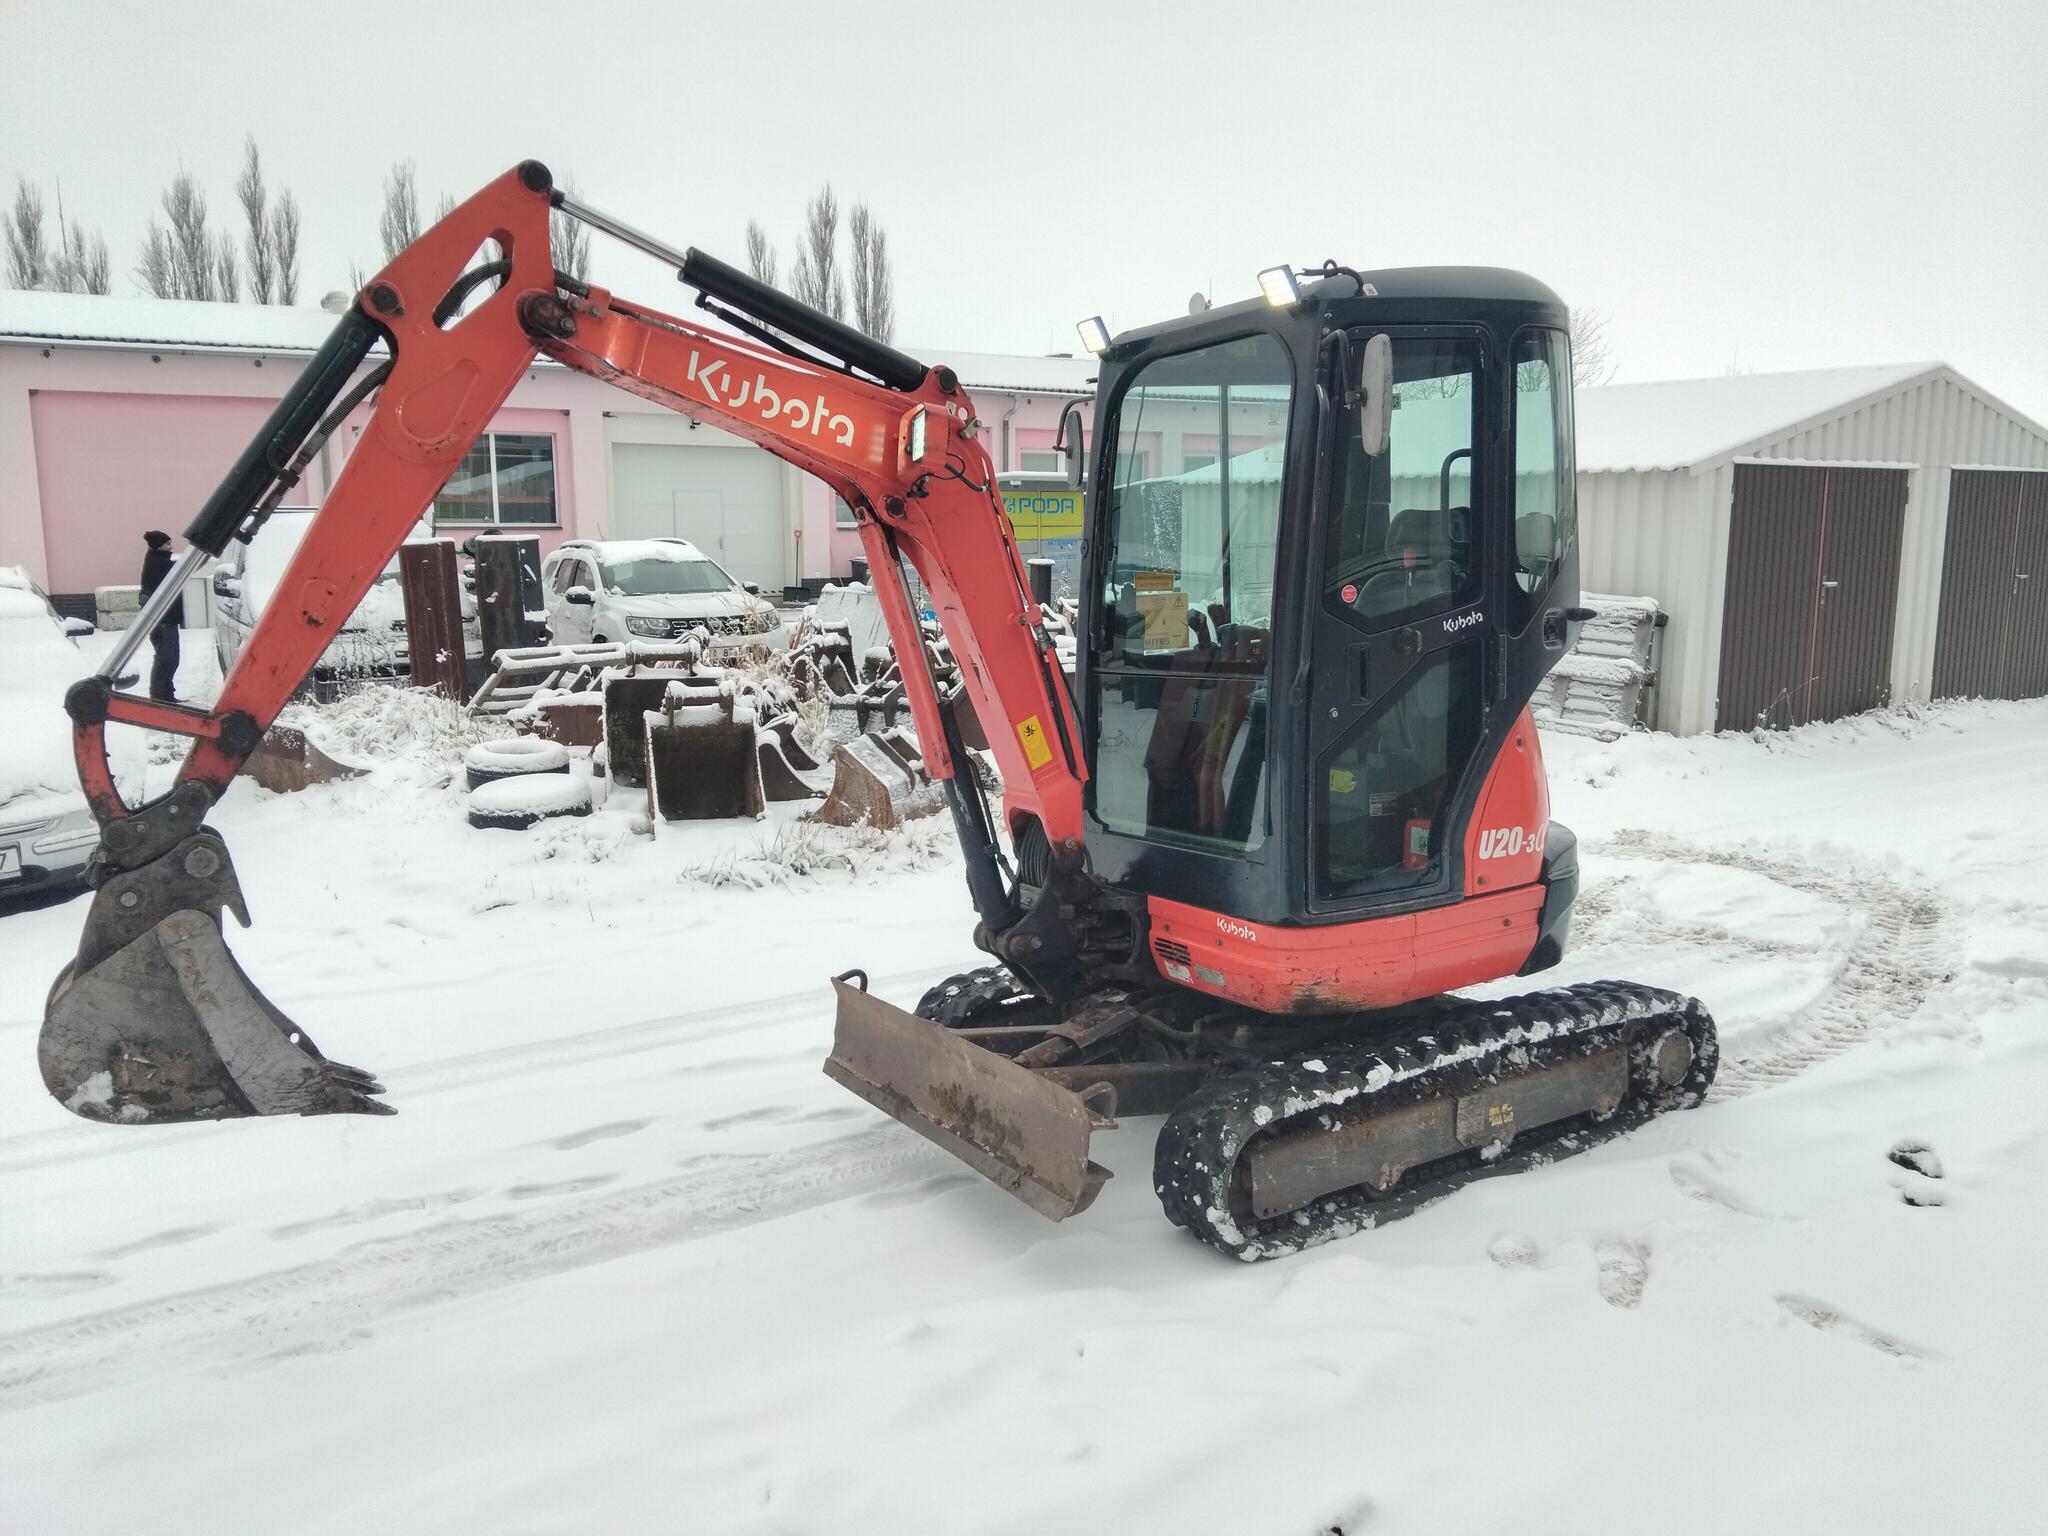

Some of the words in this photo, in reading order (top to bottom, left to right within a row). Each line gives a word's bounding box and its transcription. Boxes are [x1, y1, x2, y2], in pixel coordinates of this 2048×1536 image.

[682, 350, 856, 447] Kubota
[1019, 497, 1074, 514] PODA
[1443, 611, 1484, 632] Kubota
[1216, 918, 1256, 942] Kubota
